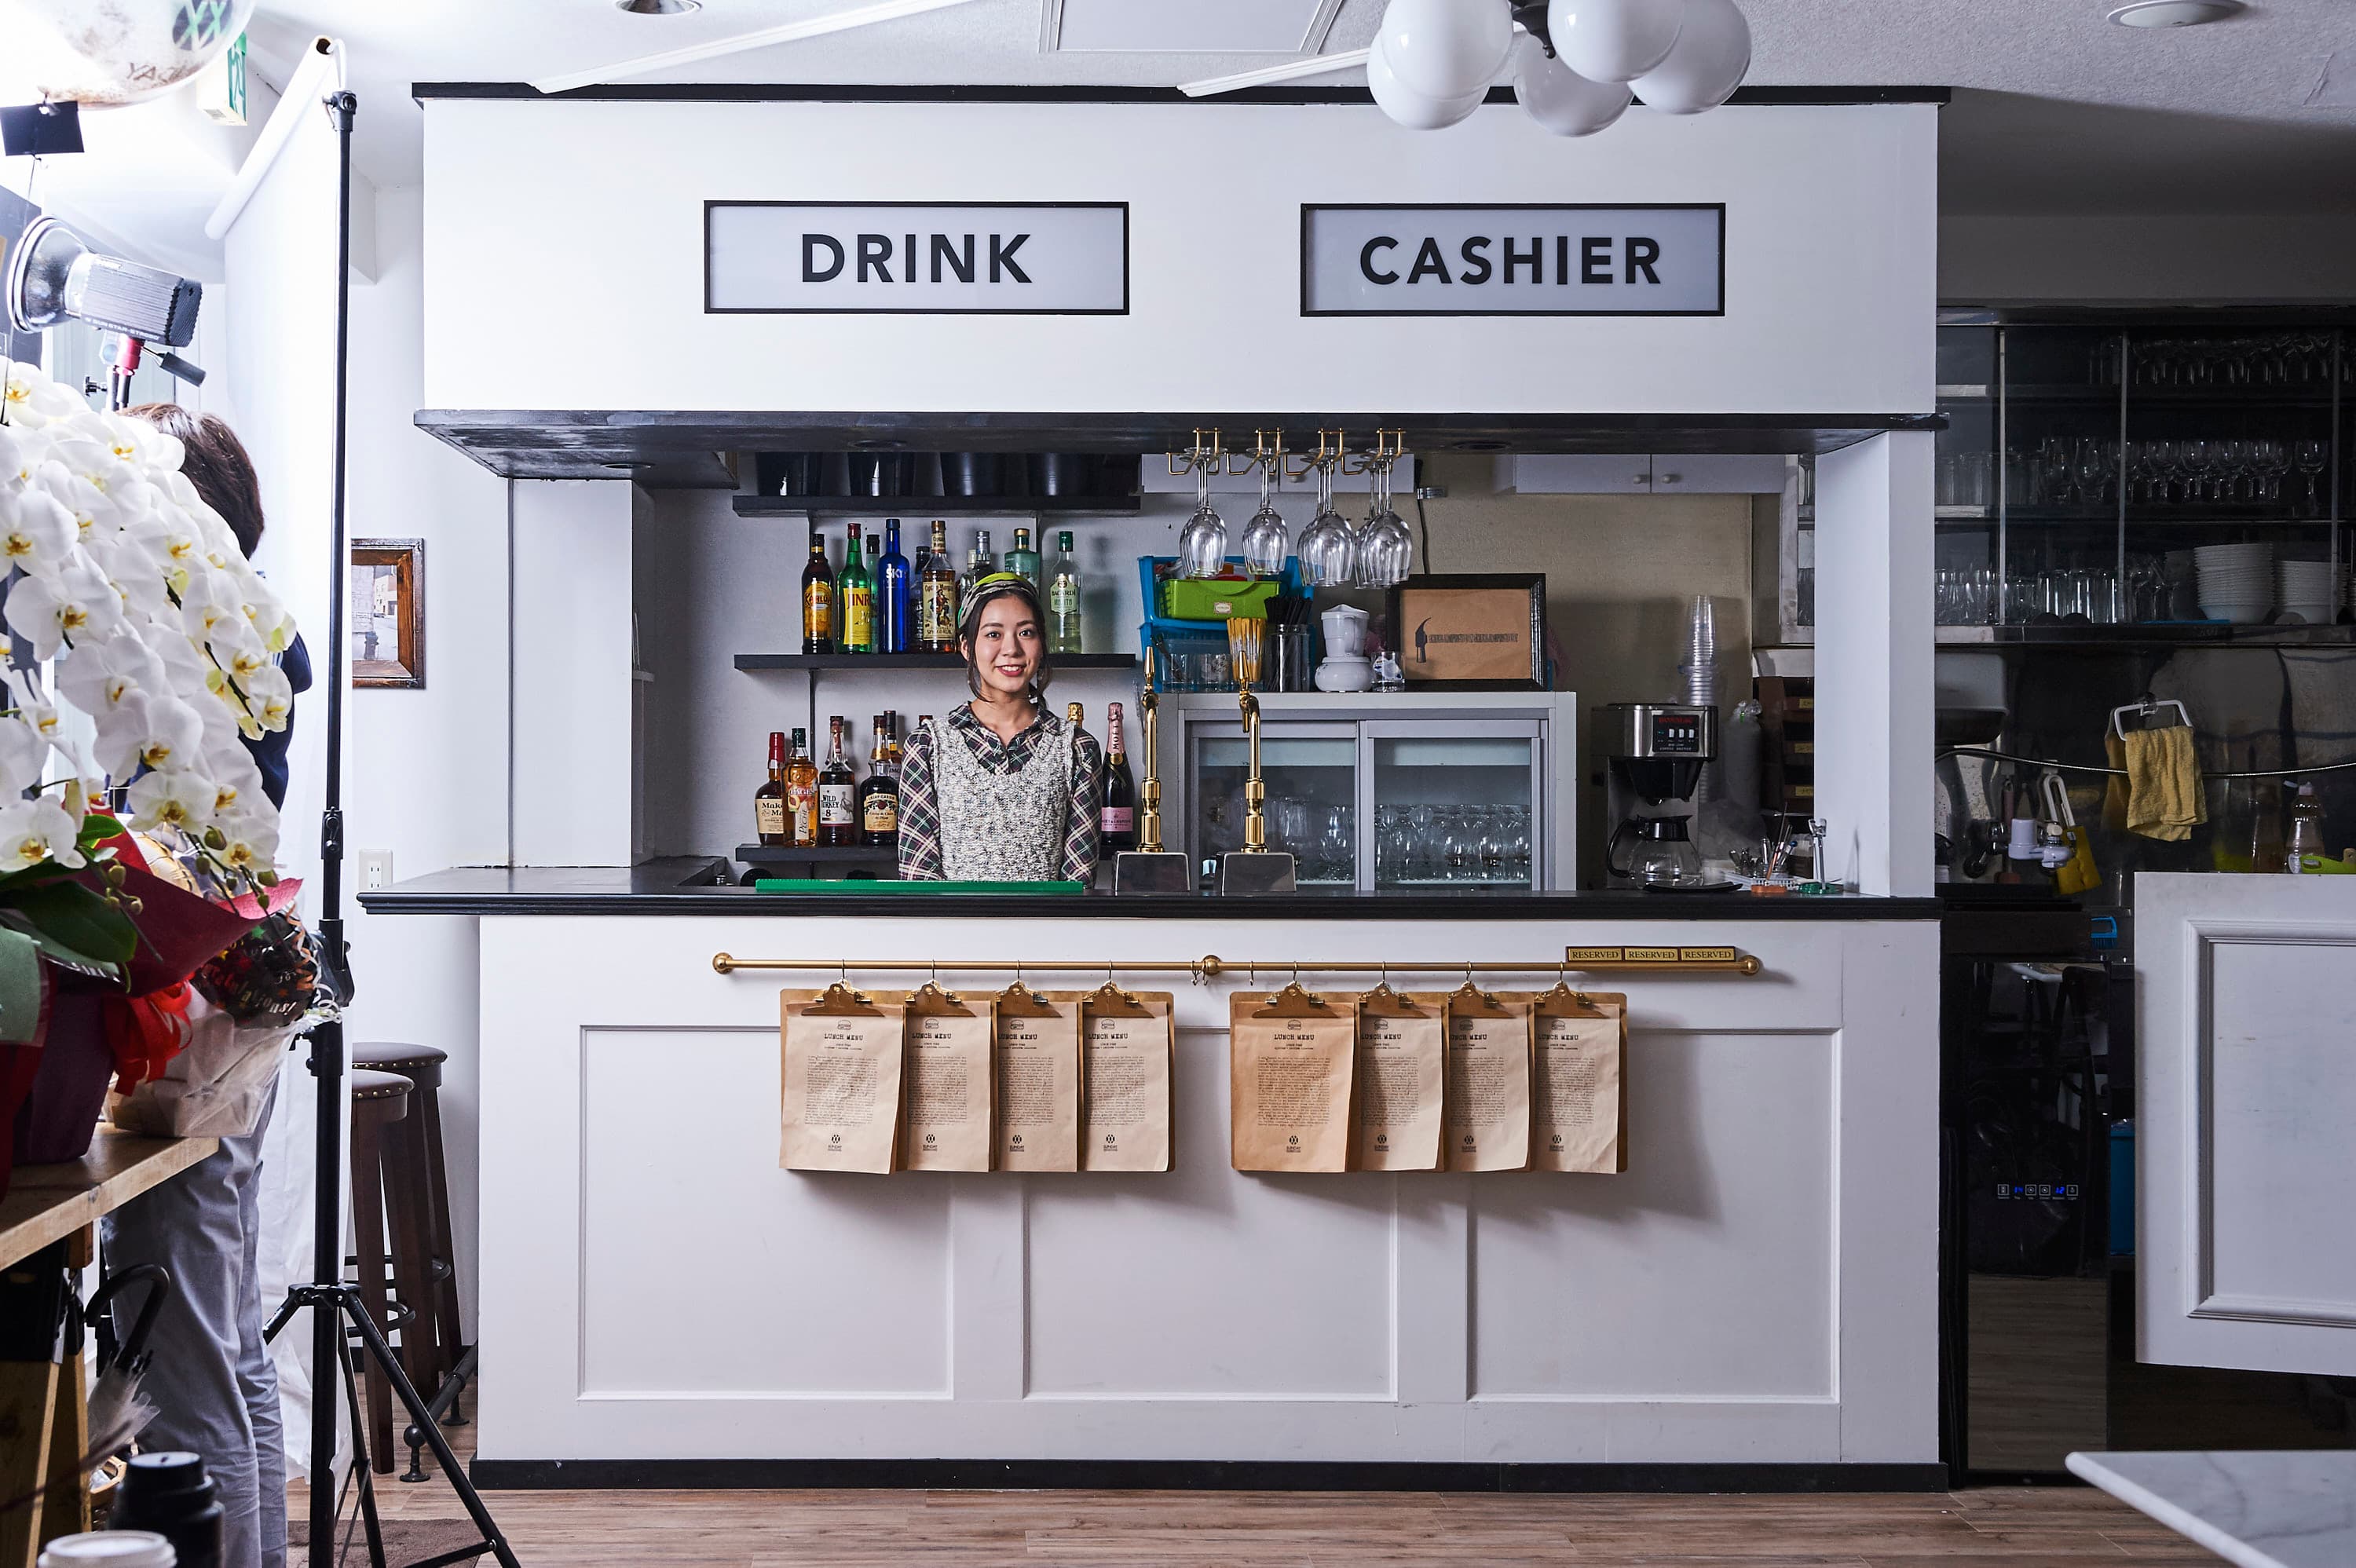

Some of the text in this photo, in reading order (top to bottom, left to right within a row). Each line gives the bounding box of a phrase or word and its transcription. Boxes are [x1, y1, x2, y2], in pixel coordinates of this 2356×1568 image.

[802, 234, 1033, 283] DRINK
[1360, 236, 1662, 285] CASHIER
[847, 594, 871, 610] JINR
[825, 809, 832, 817] 8
